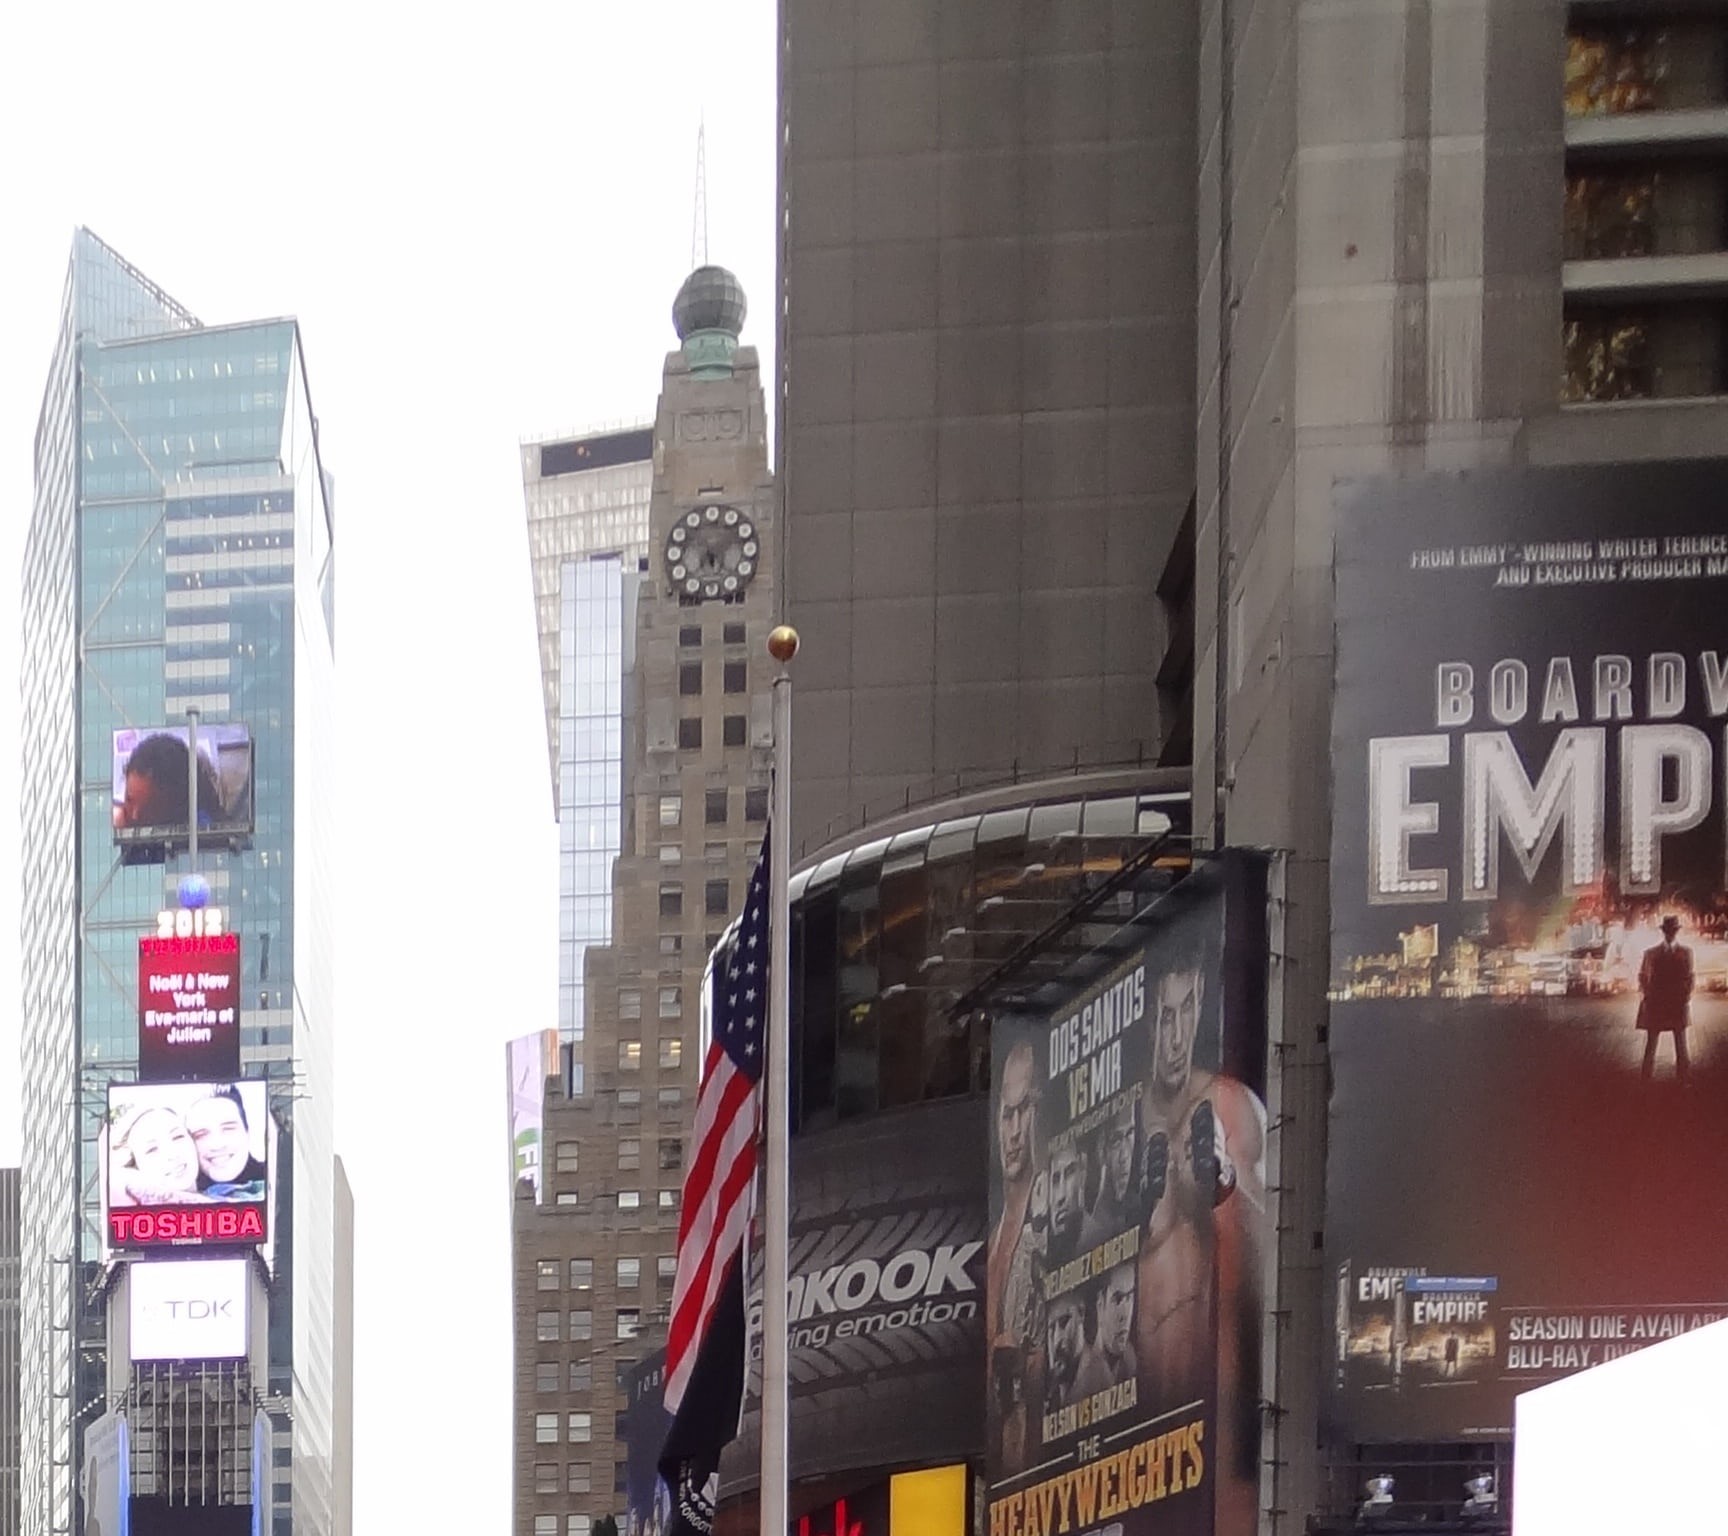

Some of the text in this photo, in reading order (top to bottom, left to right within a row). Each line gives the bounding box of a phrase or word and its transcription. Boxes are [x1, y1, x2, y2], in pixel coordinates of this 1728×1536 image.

[1411, 550, 1455, 568] FROM
[1599, 537, 1658, 557] WRITER
[1496, 558, 1701, 585] AND EXECUTIVE PRODUCER
[1368, 724, 1728, 905] EMP
[157, 908, 223, 939] 2012
[1049, 965, 1145, 1081] DOS SANTOS
[1069, 1039, 1122, 1120] VS MIR
[111, 1208, 263, 1241] TOSHIBA
[749, 1240, 985, 1334] anKOOK
[163, 1298, 233, 1320] TDK
[835, 1300, 977, 1338] emotion
[1413, 1301, 1489, 1325] EMPIRE
[1509, 1315, 1627, 1340] SEASON ONE
[1041, 1403, 1078, 1444] NELSON
[1090, 1377, 1138, 1426] GONZAGA
[1078, 1434, 1101, 1464] THE
